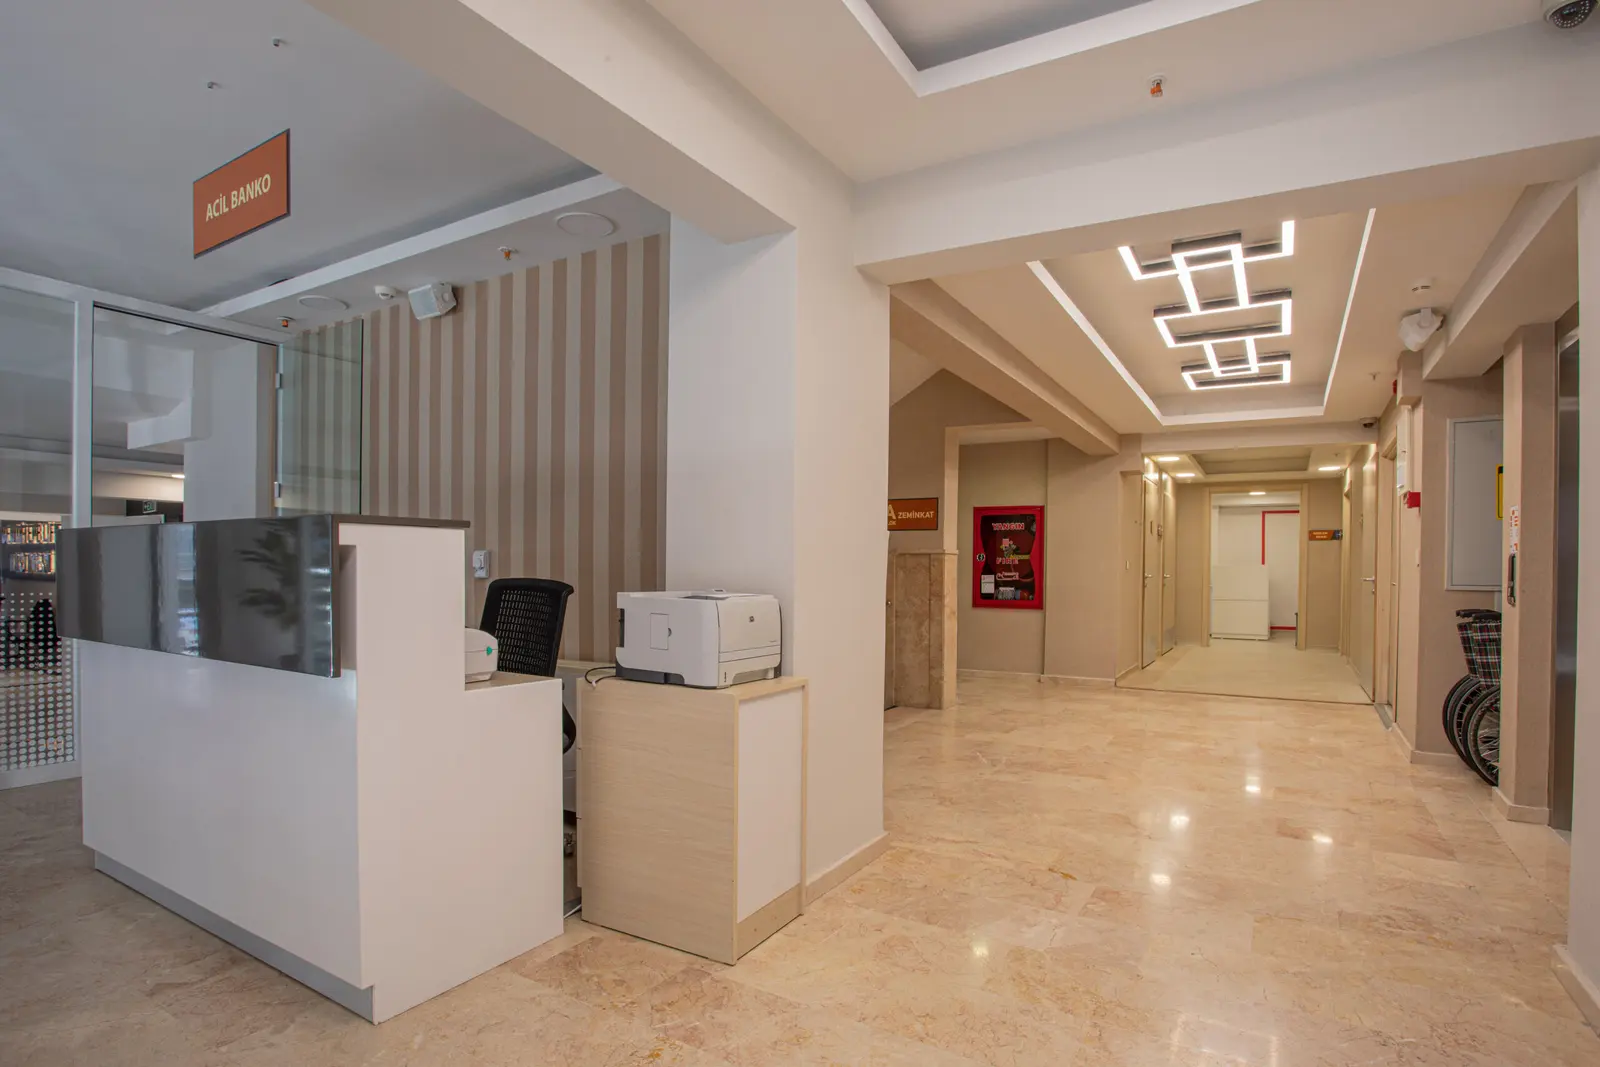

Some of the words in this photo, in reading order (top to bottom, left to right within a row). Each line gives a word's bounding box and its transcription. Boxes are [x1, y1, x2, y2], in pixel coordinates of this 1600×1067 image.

[206, 193, 229, 222] ACİL
[231, 174, 271, 209] BANKO
[897, 510, 935, 519] ZEMİNKAT
[991, 522, 1025, 531] YANGIN
[996, 557, 1019, 565] FIRE
